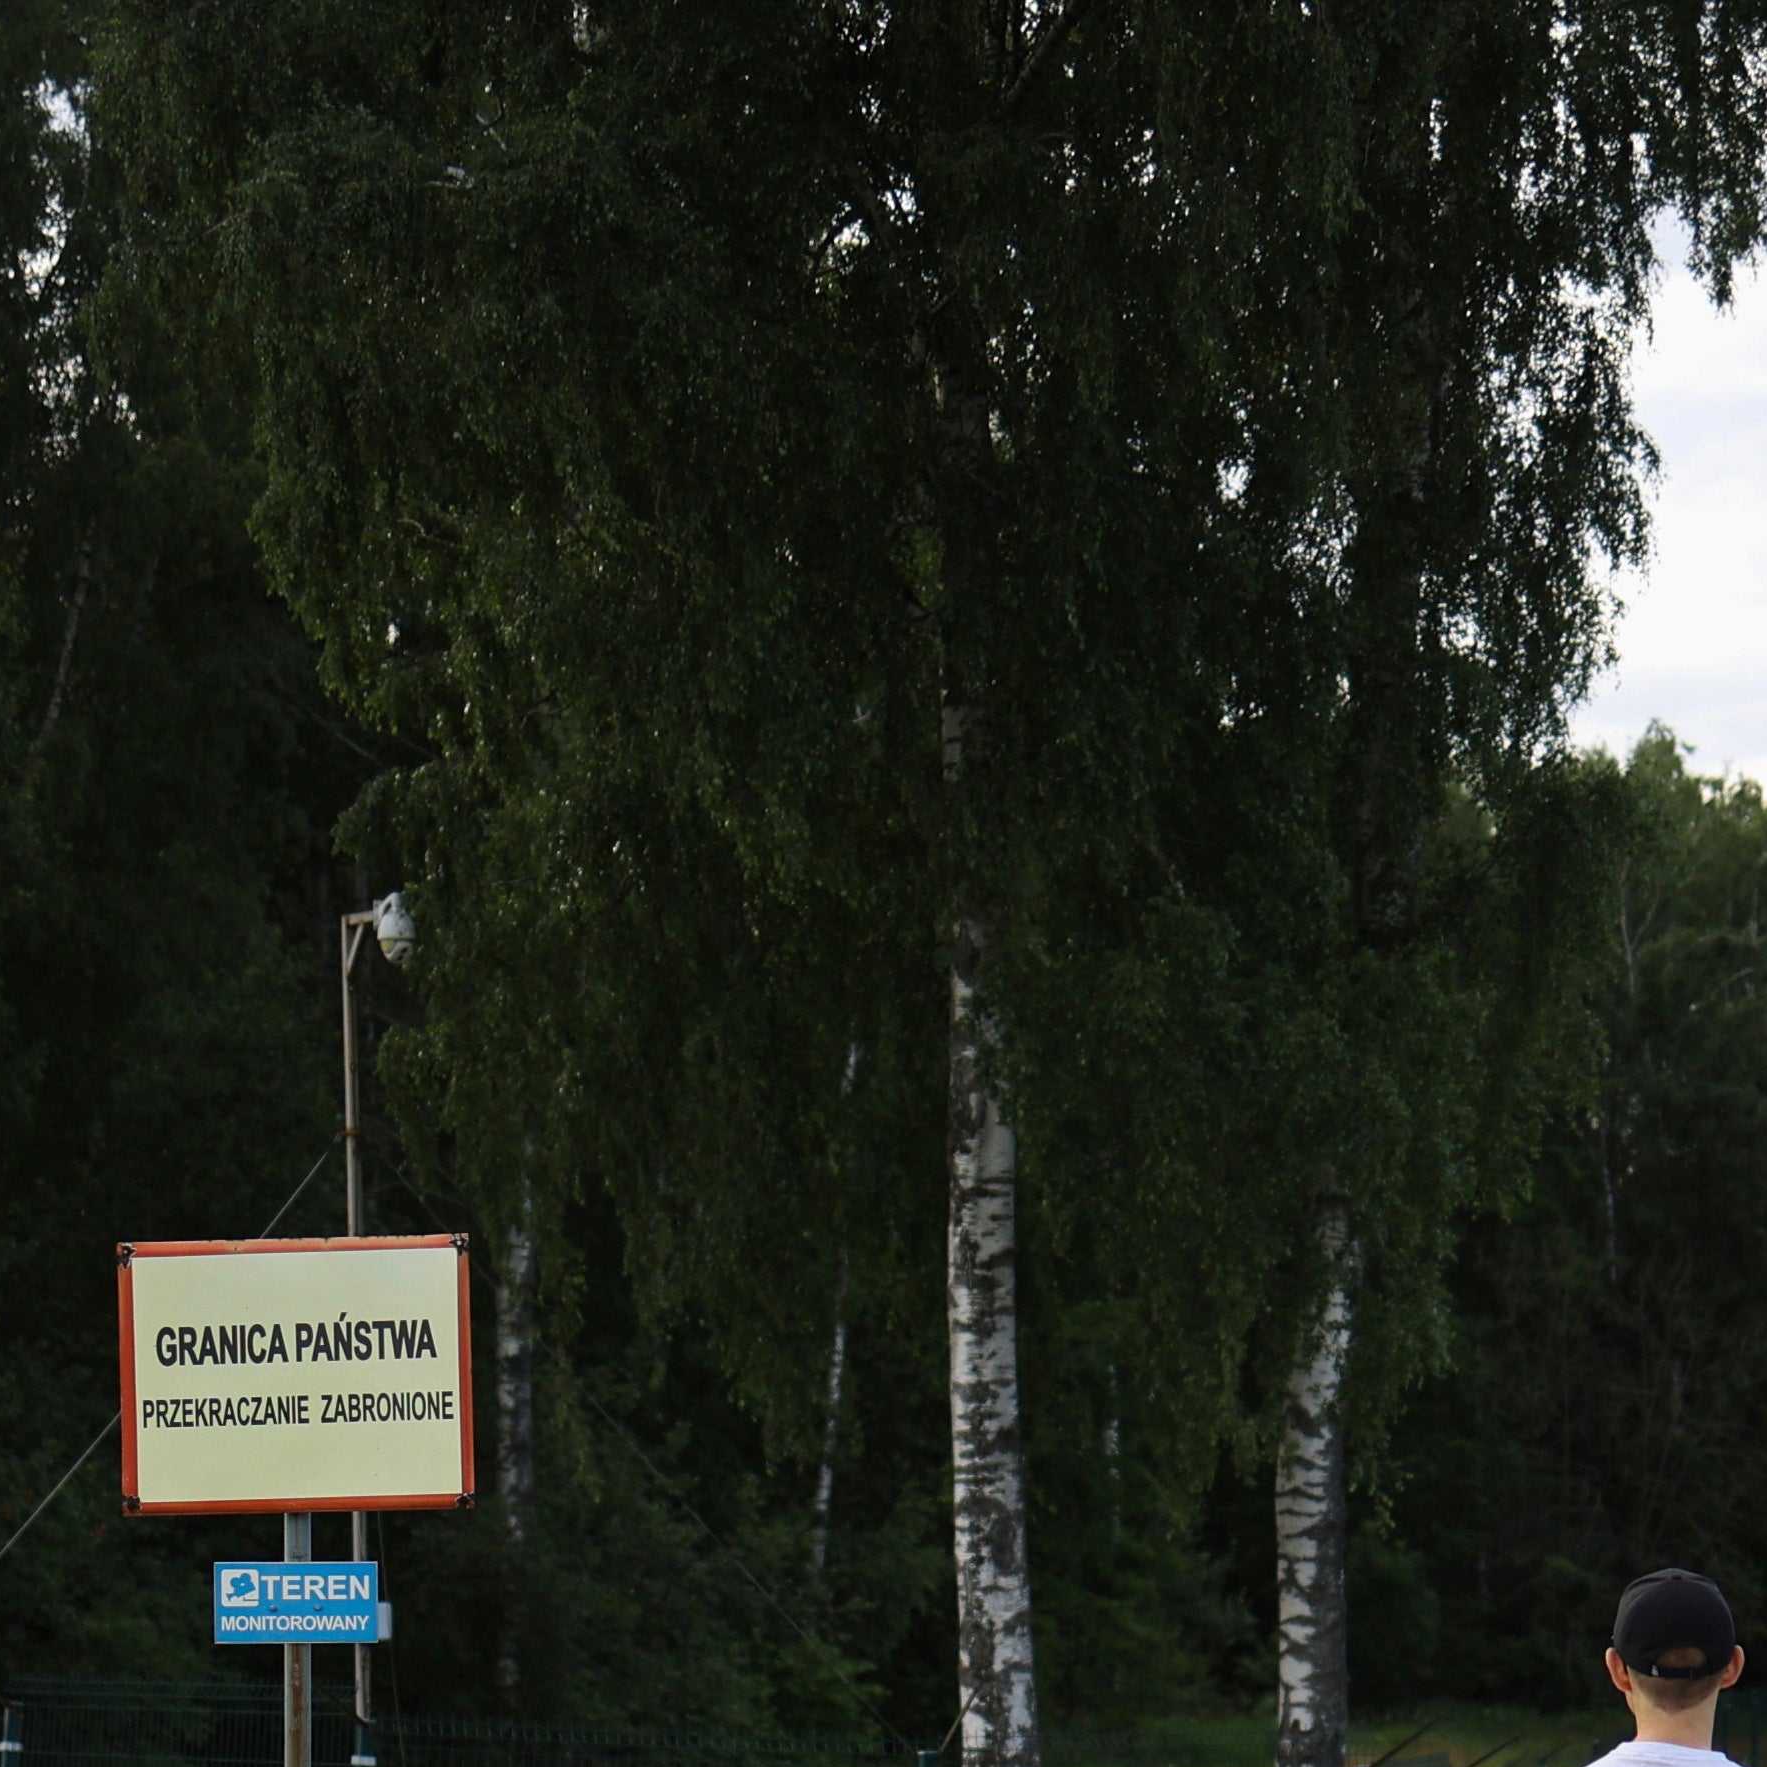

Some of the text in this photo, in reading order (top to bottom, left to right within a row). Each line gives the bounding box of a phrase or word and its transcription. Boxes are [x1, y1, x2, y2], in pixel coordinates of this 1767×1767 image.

[156, 1312, 437, 1367] GRANICA PAŃSTWA
[142, 1391, 454, 1428] PRZEKRACZANIE ZABRONIONE
[260, 1575, 370, 1600] TEREN
[220, 1615, 370, 1631] MONITOROWANY
